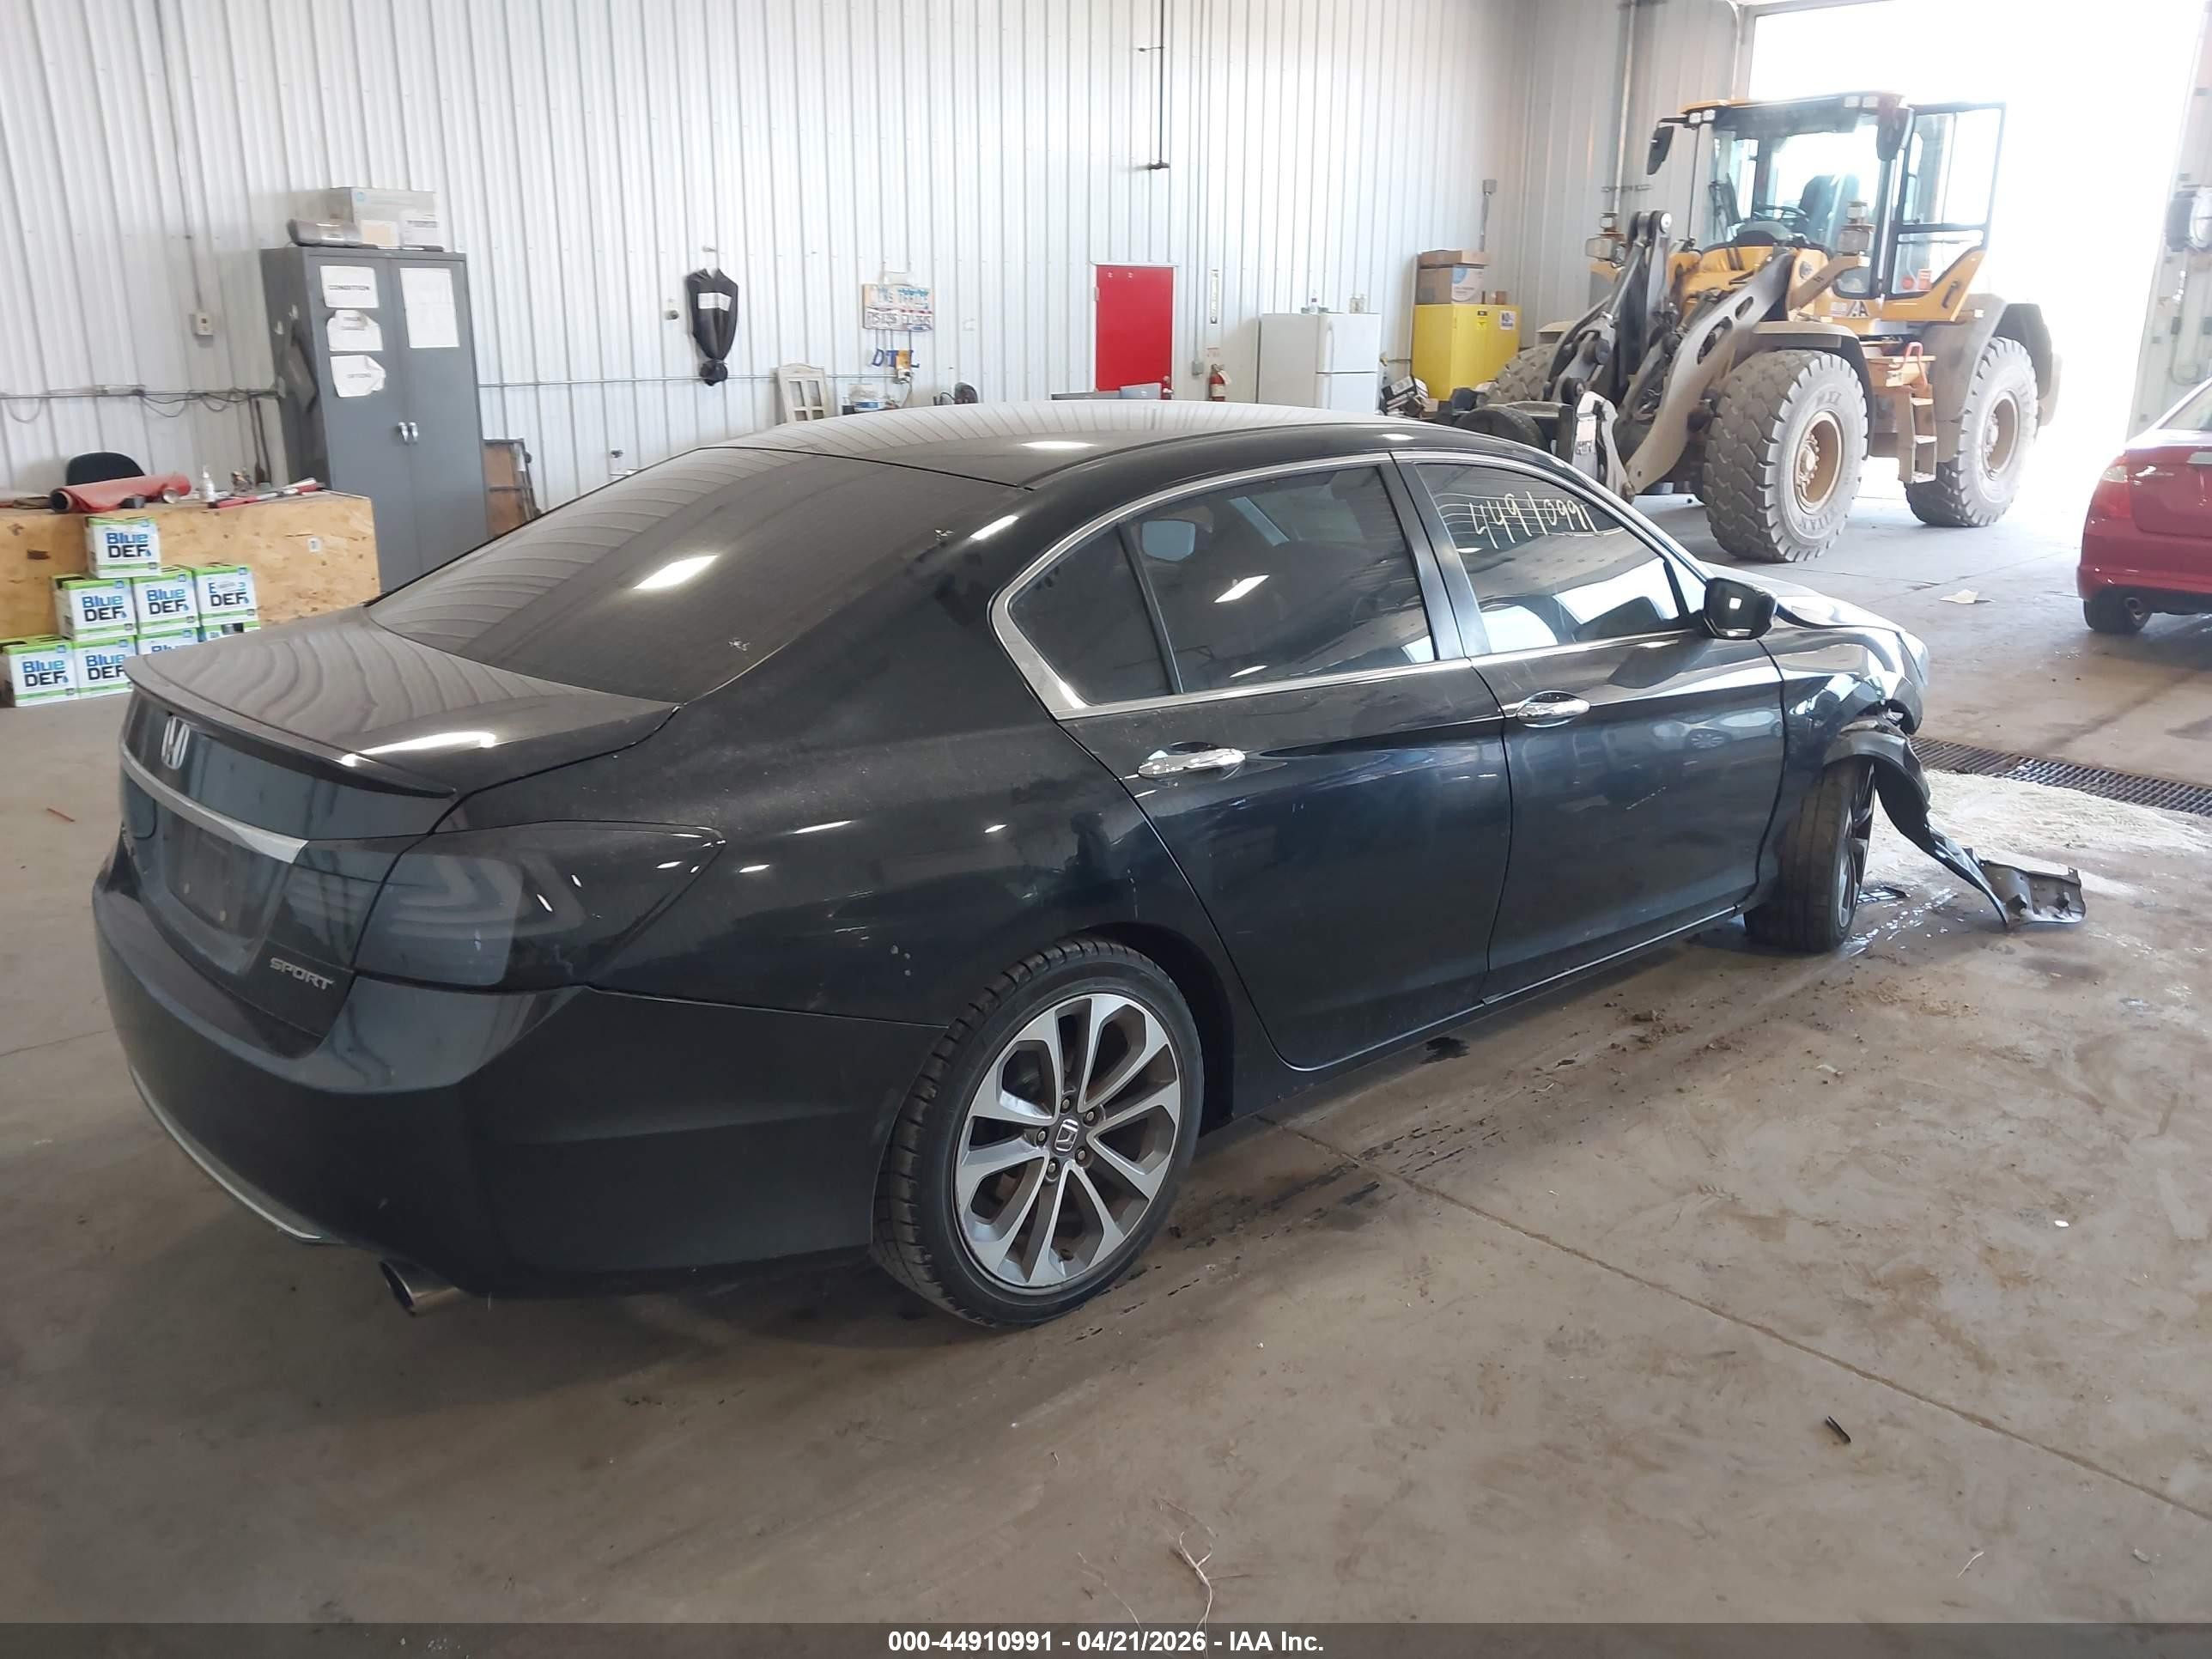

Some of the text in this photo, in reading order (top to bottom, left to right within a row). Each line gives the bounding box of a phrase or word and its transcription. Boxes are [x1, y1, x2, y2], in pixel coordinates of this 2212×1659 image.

[1469, 490, 1600, 550] 44910991
[106, 532, 149, 544] Blue
[107, 544, 149, 559] DEF
[82, 595, 124, 609] Blue
[146, 588, 186, 602] Blue
[210, 592, 247, 607] DEF
[84, 606, 125, 622] DEF
[149, 599, 186, 616] DEF
[22, 659, 66, 674] Blue
[86, 653, 125, 667] Blue
[24, 671, 66, 688] DEF
[88, 665, 125, 681] DEF
[270, 956, 334, 990] SPORT
